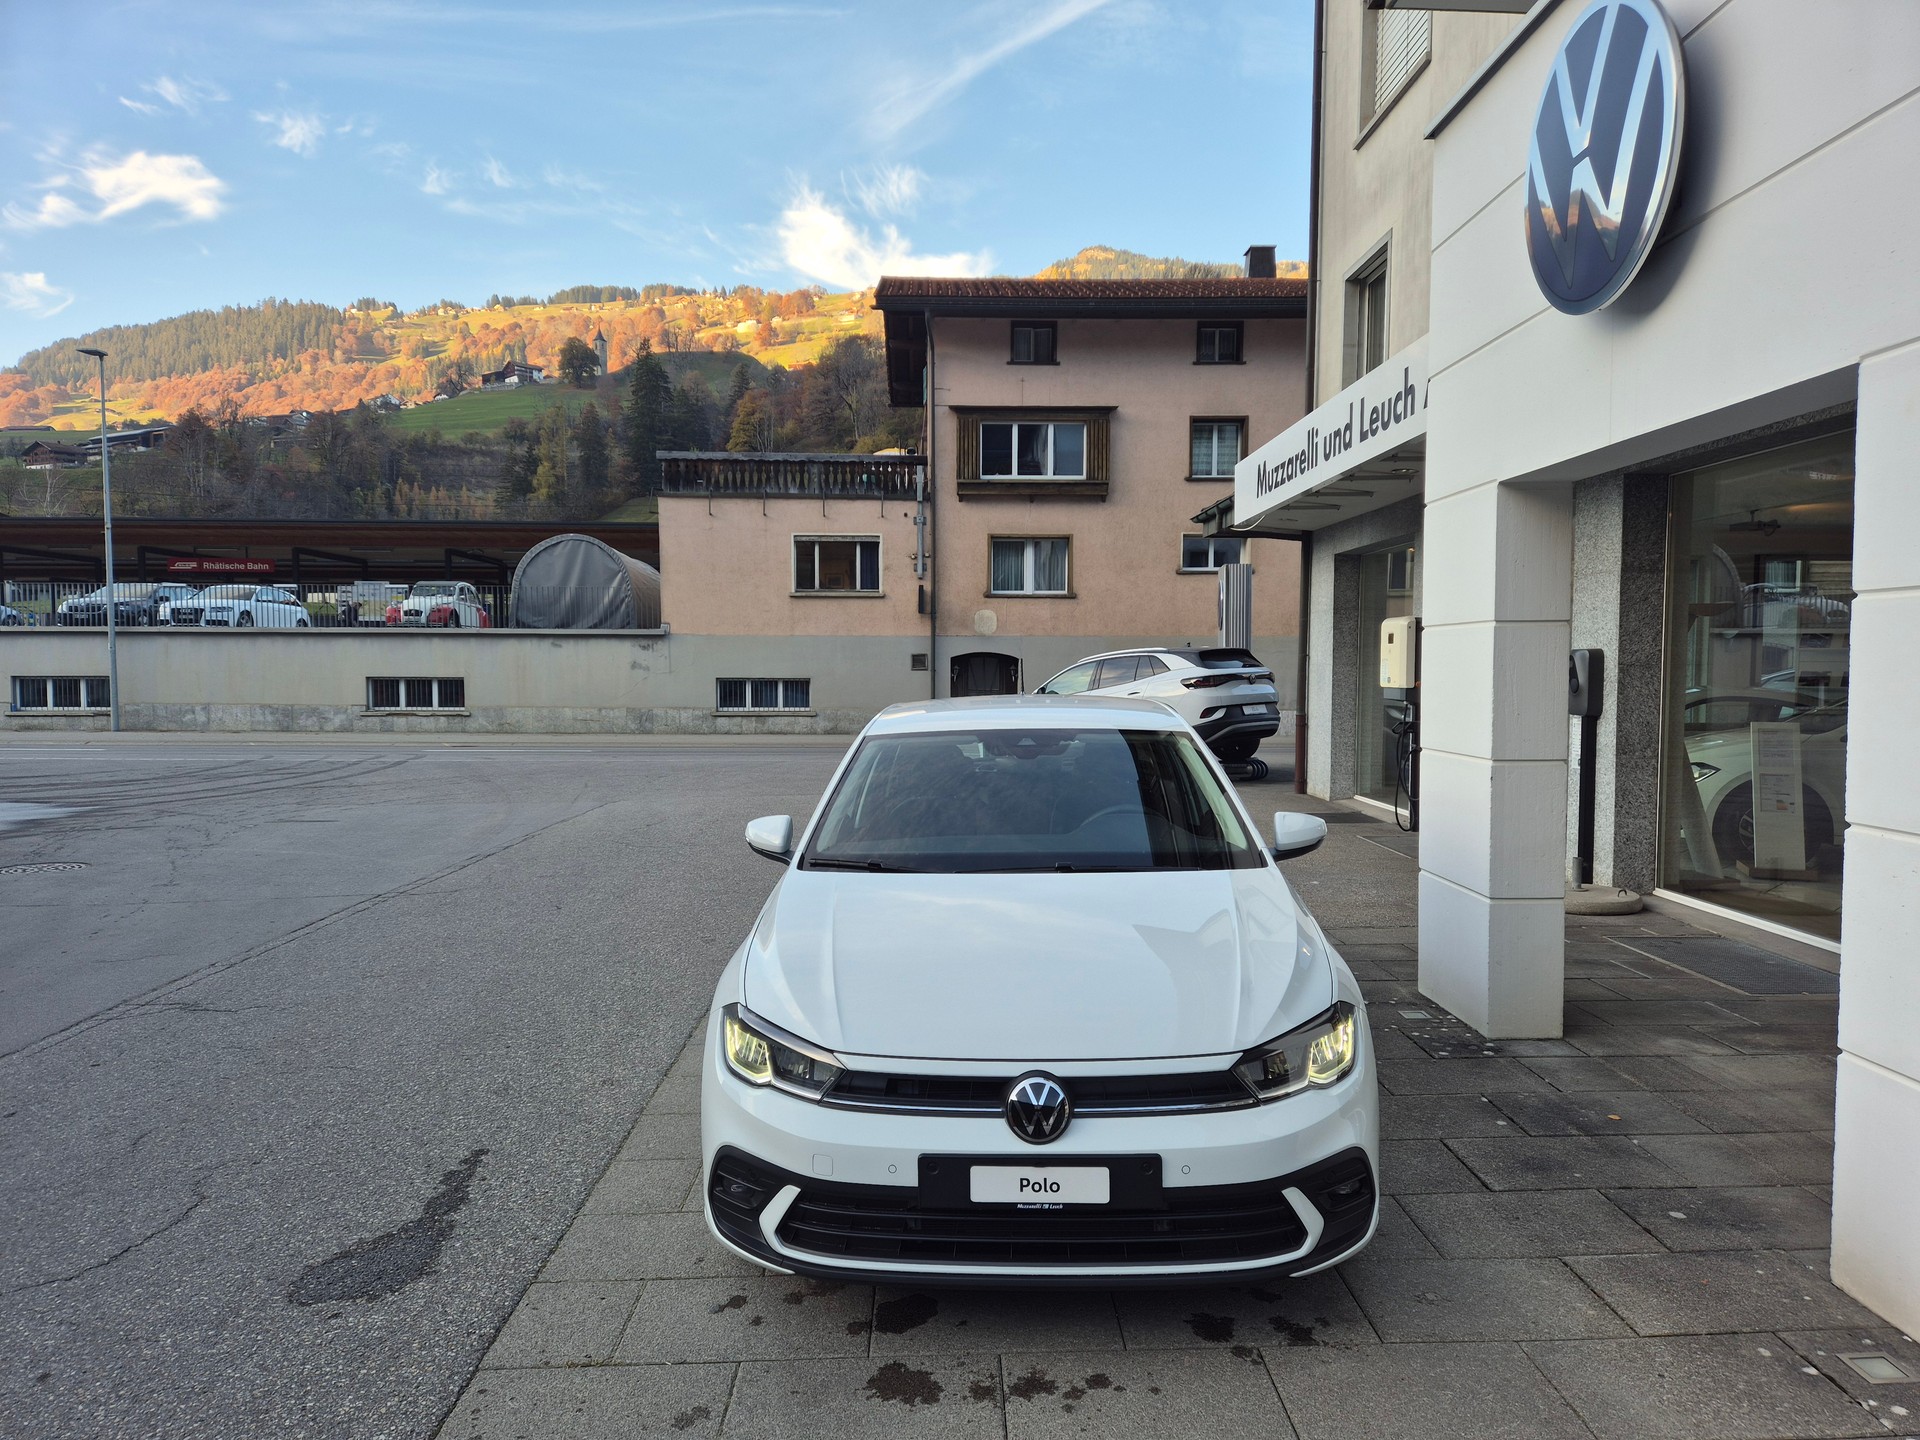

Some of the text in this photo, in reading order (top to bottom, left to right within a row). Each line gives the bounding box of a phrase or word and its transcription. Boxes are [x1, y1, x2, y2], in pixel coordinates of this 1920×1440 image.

[1256, 426, 1319, 499] Muzzarelli
[1323, 401, 1354, 462] und
[1359, 366, 1416, 443] Leuch
[203, 561, 269, 570] Rhätische Bahn
[1019, 1177, 1061, 1194] Polo
